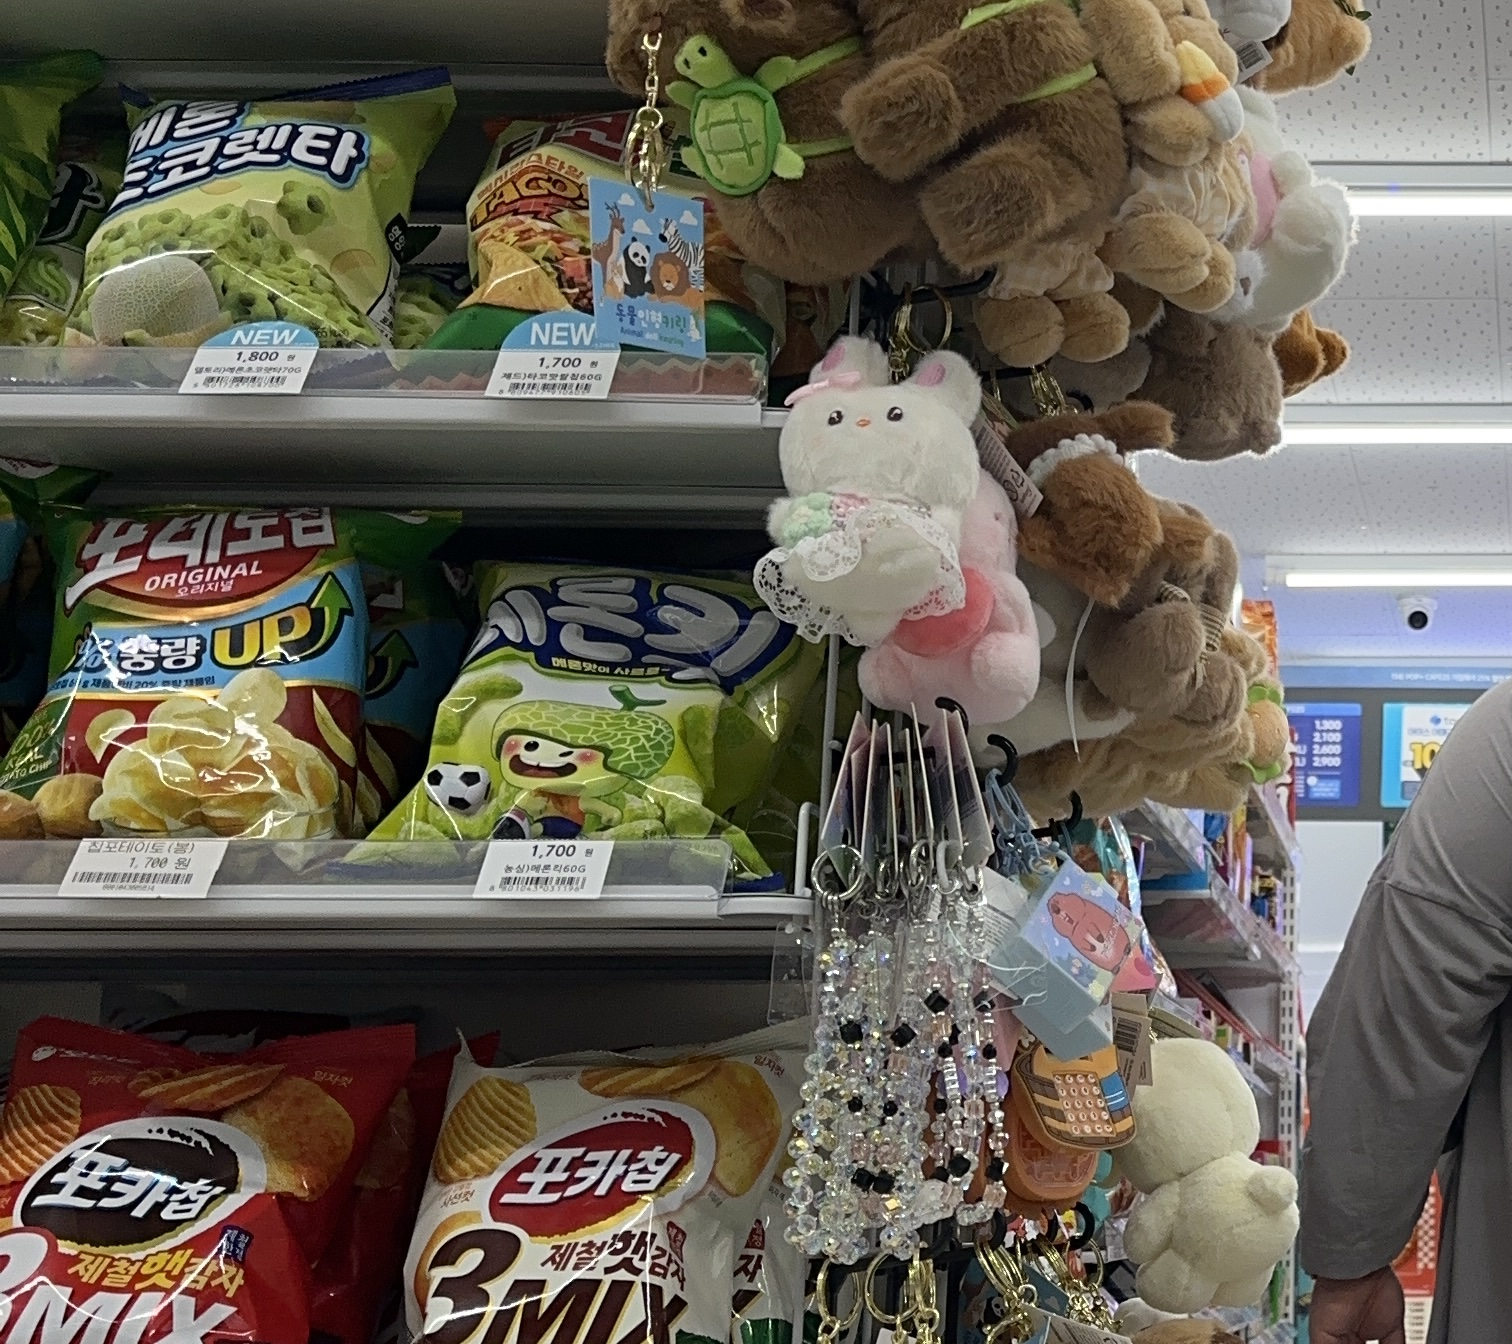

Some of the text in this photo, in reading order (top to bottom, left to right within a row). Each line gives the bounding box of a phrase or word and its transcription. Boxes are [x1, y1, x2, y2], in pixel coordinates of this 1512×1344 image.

[231, 329, 300, 346] NEW
[530, 322, 594, 346] NEW
[236, 351, 279, 362] 1,800
[538, 356, 582, 370] 1,700
[144, 560, 264, 594] ORIGINAL
[176, 579, 235, 597] 오리지널
[212, 603, 313, 668] UP
[530, 844, 577, 859] 1,700
[174, 857, 192, 871] 원
[498, 1146, 683, 1205] 포카칩
[30, 1149, 227, 1221] 포카칩
